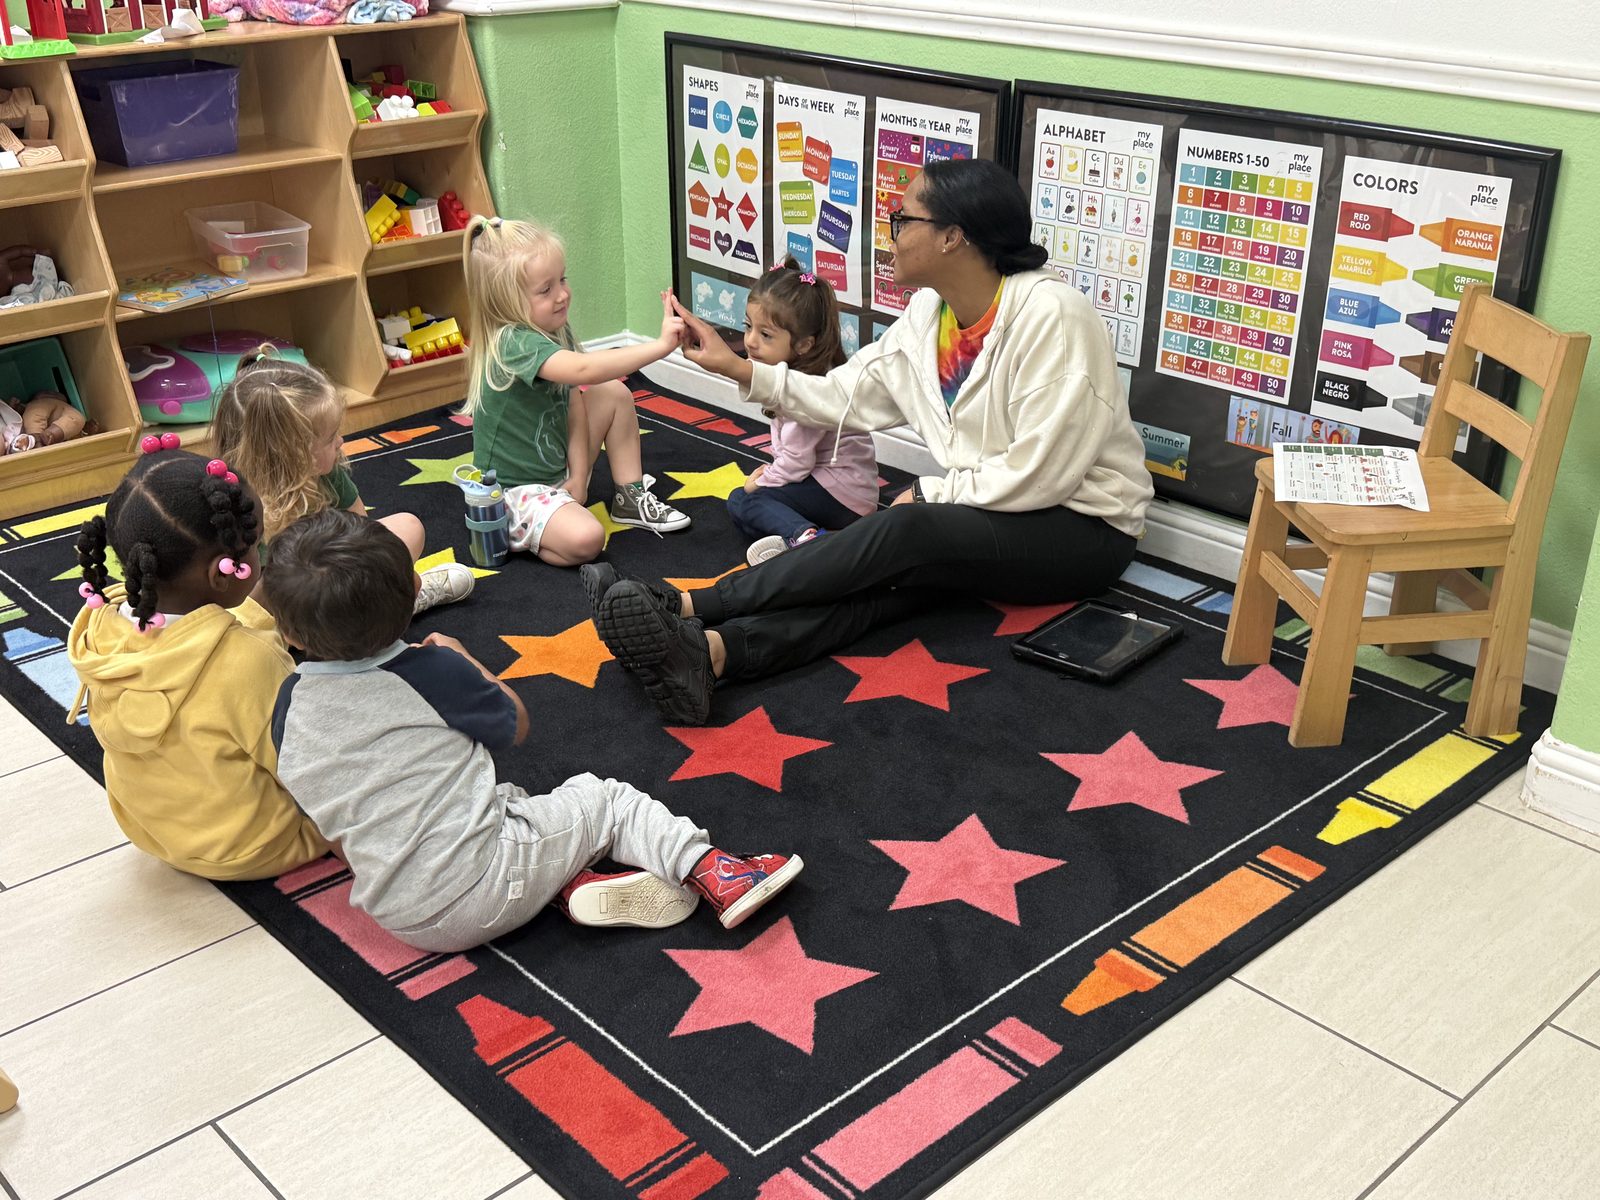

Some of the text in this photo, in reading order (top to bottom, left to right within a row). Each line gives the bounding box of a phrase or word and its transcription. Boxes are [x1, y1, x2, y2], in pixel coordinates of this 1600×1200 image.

[689, 76, 719, 92] SHAPES
[748, 83, 757, 92] my
[746, 90, 760, 100] place
[778, 94, 800, 108] DAYS
[810, 99, 835, 114] WEEK
[847, 100, 858, 109] my
[690, 107, 707, 116] SQUARE
[844, 107, 860, 118] place
[715, 113, 730, 122] CIRCLE
[737, 118, 758, 127] HEXAGON
[880, 111, 918, 128] MONTHS
[928, 120, 951, 133] YEAR
[958, 117, 970, 127] my
[955, 125, 973, 136] place
[1043, 123, 1106, 144] ALPHABET
[1137, 131, 1151, 140] my
[778, 132, 800, 141] SUNDAY
[879, 142, 900, 155] January
[1133, 139, 1154, 150] place
[805, 146, 830, 162] MONDAY
[882, 150, 898, 160] Enero
[927, 150, 951, 161] February
[1091, 153, 1100, 163] Cc
[1187, 145, 1270, 168] NUMBERS 1-50
[1293, 153, 1309, 164] my
[717, 158, 728, 166] OVAL
[1113, 156, 1124, 166] Dd
[803, 163, 818, 174] LUNES
[1190, 166, 1196, 177] 1
[1288, 161, 1312, 174] place
[831, 170, 856, 182] TUESDAY
[878, 172, 895, 182] March
[1216, 170, 1222, 180] 2
[1241, 174, 1248, 184] 3
[880, 181, 897, 191] Marzo
[1268, 178, 1275, 189] 4
[1296, 183, 1302, 193] 5
[1353, 172, 1419, 195] COLORS
[831, 188, 850, 198] MARTES
[1044, 187, 1053, 196] Ff
[1187, 188, 1194, 198] 6
[1477, 184, 1495, 196] my
[689, 192, 709, 203] PENTAGON
[782, 193, 813, 201] WEDNESDAY
[1087, 194, 1098, 204] Hh
[1213, 192, 1220, 202] 7
[1239, 196, 1246, 207] 8
[1470, 193, 1498, 206] place
[717, 202, 728, 210] STAR
[877, 203, 888, 212] May
[1266, 201, 1273, 211] 9
[1290, 205, 1302, 216] 10
[737, 208, 757, 218] DIAMOND
[880, 210, 891, 220] May
[1184, 210, 1193, 220] 11
[1353, 212, 1370, 222] RED
[821, 210, 850, 232] THURSDAY
[1208, 214, 1219, 225] 12
[1234, 218, 1246, 229] 13
[1040, 226, 1049, 235] Kk
[1261, 223, 1272, 234] 14
[1349, 220, 1371, 231] ROJO
[818, 227, 835, 241] JUEVES
[1181, 231, 1192, 241] 16
[1288, 228, 1299, 238] 15
[1457, 229, 1494, 242] ORANGE
[717, 239, 730, 248] HEART
[1082, 235, 1096, 244] Mm
[1206, 235, 1217, 246] 17
[1455, 238, 1493, 252] NARANJA
[789, 241, 809, 253] FRIDAY
[1232, 240, 1243, 251] 18
[1258, 245, 1270, 256] 19
[735, 250, 756, 260] TRAPEZOID
[1179, 252, 1189, 262] 21
[1284, 250, 1297, 261] 20
[1341, 255, 1373, 266] YELLOW
[817, 260, 845, 272] SATURDAY
[876, 260, 895, 272] Septem
[1203, 257, 1215, 267] 22
[1229, 261, 1240, 272] 23
[1255, 266, 1266, 277] 24
[1338, 264, 1373, 276] AMARILLO
[1176, 273, 1187, 283] 26
[1282, 271, 1294, 282] 25
[1454, 275, 1483, 285] GRE
[1201, 278, 1212, 288] 27
[1226, 283, 1238, 293] 28
[876, 289, 901, 301] November
[1252, 288, 1264, 298] 29
[1278, 293, 1291, 304] 30
[1174, 294, 1185, 304] 31
[1198, 299, 1210, 309] 32
[1340, 298, 1359, 308] BLUE
[1224, 304, 1235, 314] 33
[1250, 309, 1261, 320] 34
[1338, 307, 1358, 317] AZUL
[717, 311, 736, 326] Windy
[1172, 314, 1183, 324] 36
[1276, 315, 1288, 326] 35
[1196, 319, 1207, 330] 37
[1221, 325, 1233, 335] 38
[1170, 334, 1180, 344] 41
[1247, 330, 1258, 341] 39
[1194, 340, 1205, 350] 42
[1273, 337, 1285, 347] 40
[1333, 340, 1353, 351] PINK
[1219, 345, 1230, 356] 43
[1331, 348, 1352, 359] ROSA
[1168, 353, 1178, 364] 46
[1244, 351, 1255, 362] 44
[1192, 359, 1203, 370] 47
[1270, 357, 1281, 368] 45
[1216, 366, 1227, 376] 48
[1241, 371, 1253, 382] 49
[1267, 378, 1279, 389] 50
[1324, 380, 1349, 392] BLACK
[1322, 388, 1350, 400] NEGRO
[1271, 421, 1292, 438] Fall
[1141, 427, 1185, 449] Summer
